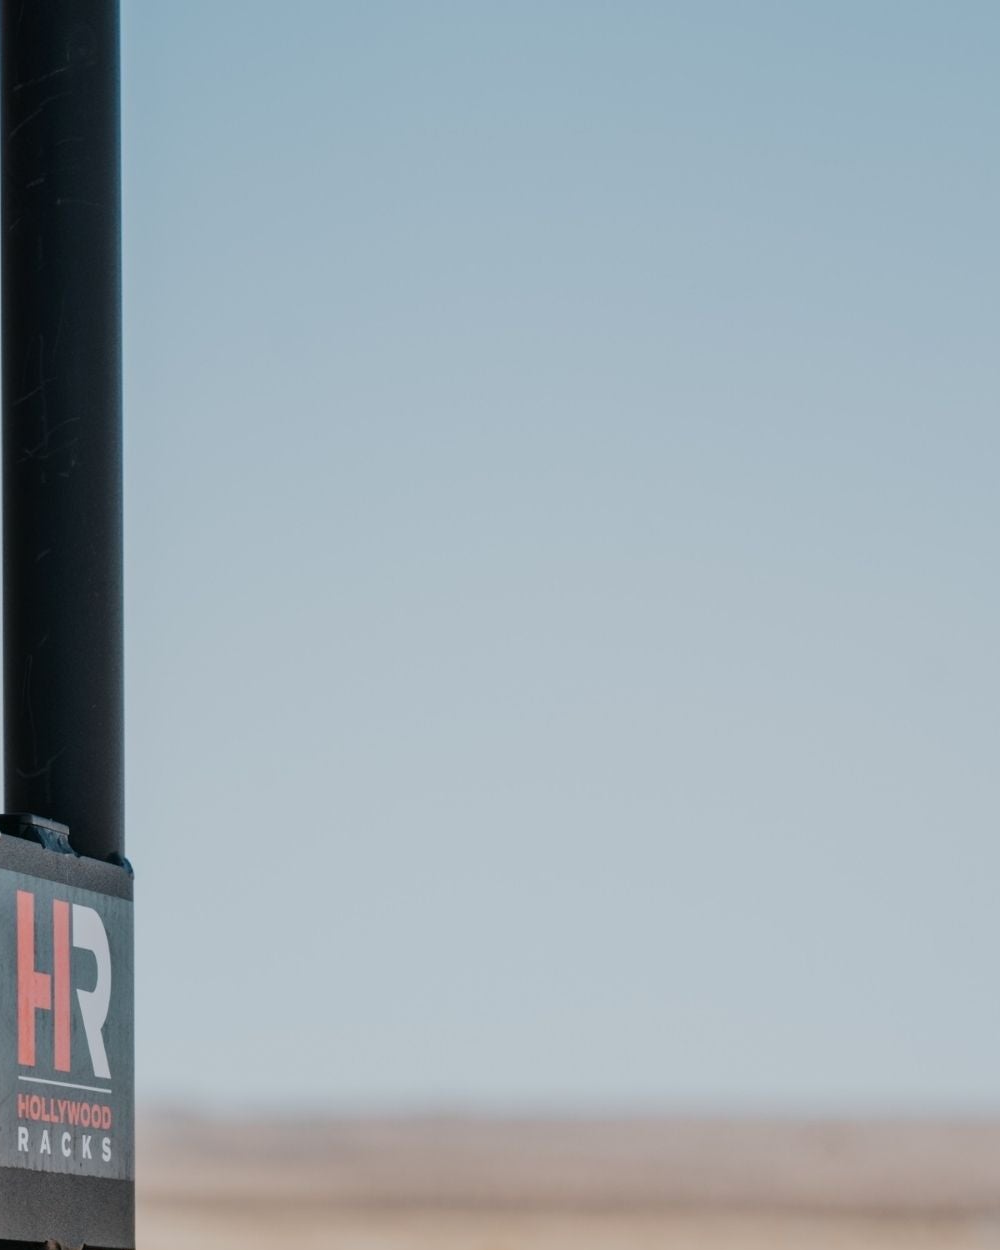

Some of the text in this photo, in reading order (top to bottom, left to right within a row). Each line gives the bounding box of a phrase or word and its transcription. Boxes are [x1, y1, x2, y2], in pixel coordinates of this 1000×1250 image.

[16, 889, 112, 1079] HR
[17, 1094, 112, 1130] HOLLYWOOD
[17, 1126, 112, 1163] RACKS
